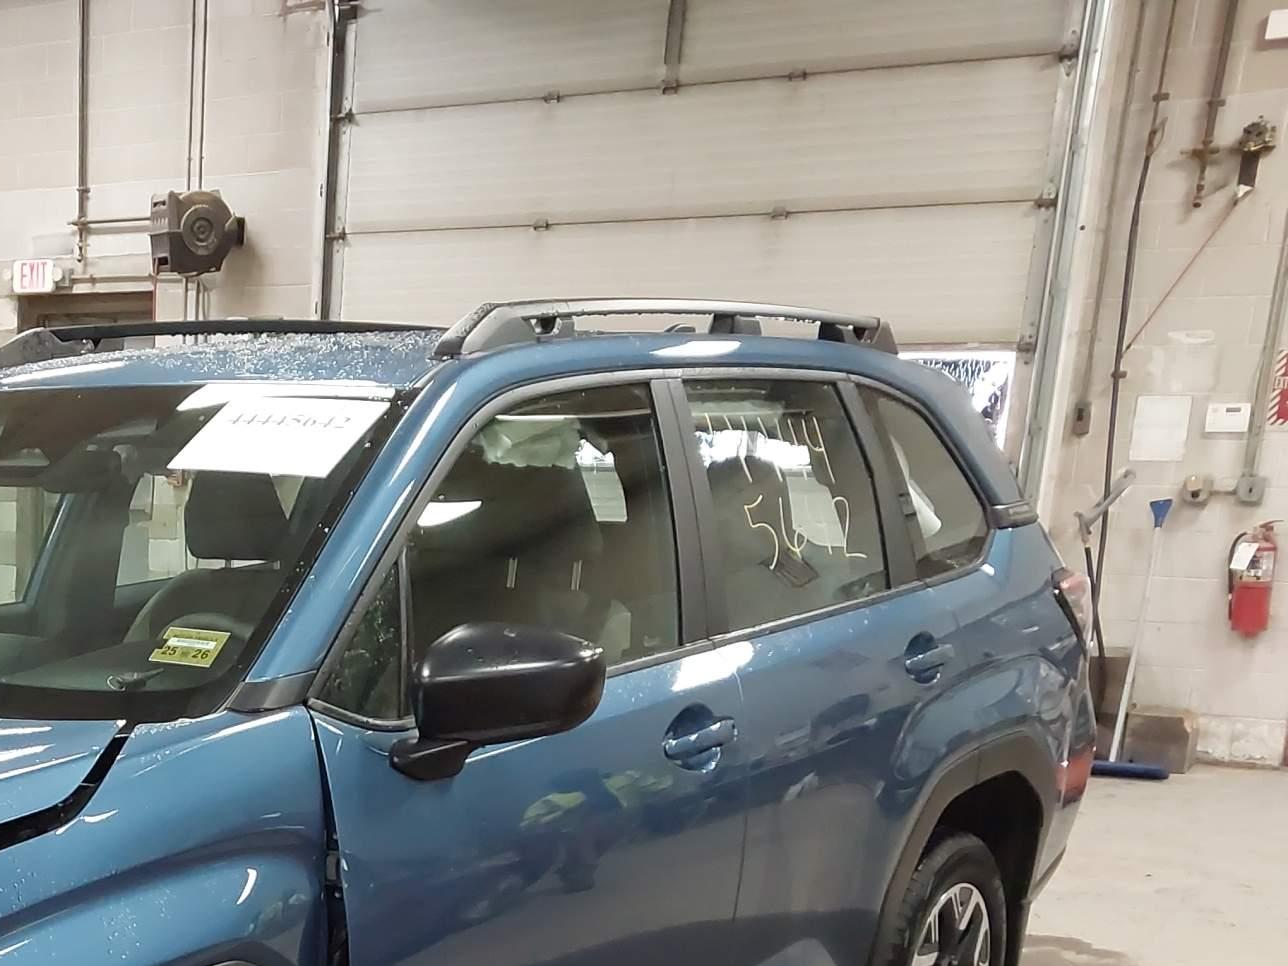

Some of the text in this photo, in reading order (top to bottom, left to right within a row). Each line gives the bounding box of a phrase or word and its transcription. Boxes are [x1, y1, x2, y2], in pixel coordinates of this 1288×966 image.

[20, 261, 48, 290] EXIT
[161, 645, 210, 660] 25 26
